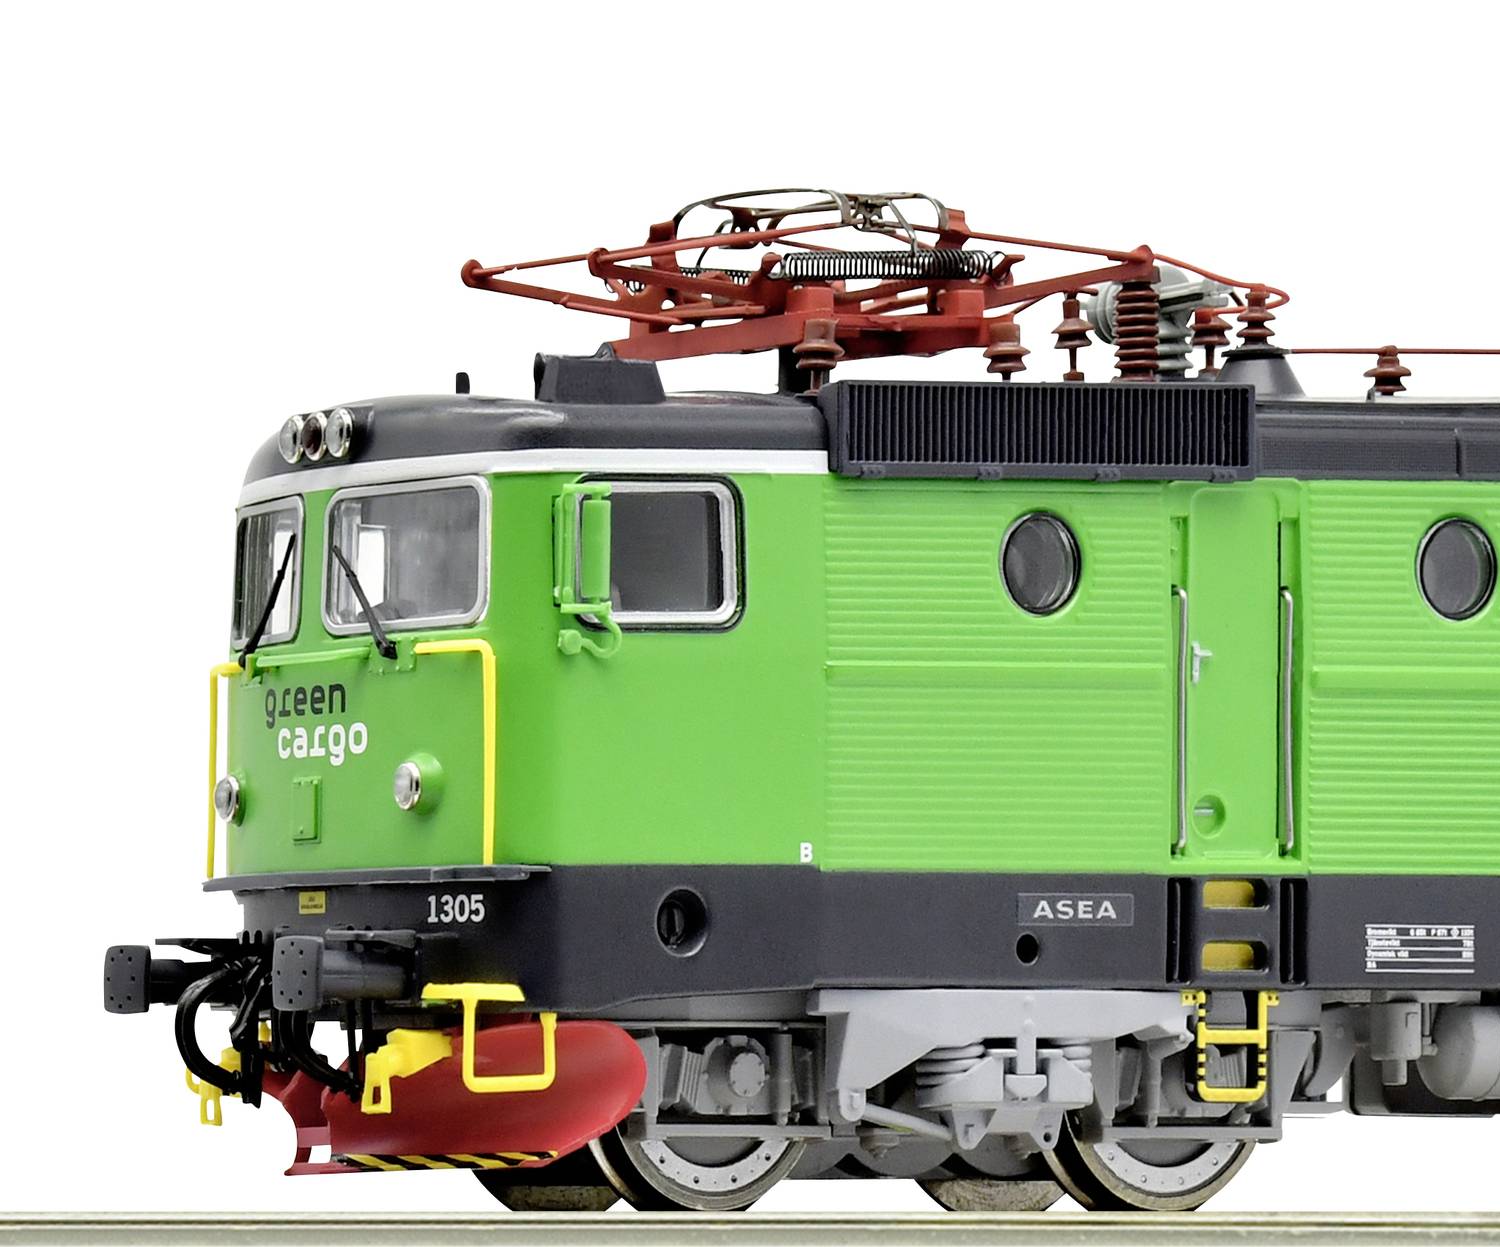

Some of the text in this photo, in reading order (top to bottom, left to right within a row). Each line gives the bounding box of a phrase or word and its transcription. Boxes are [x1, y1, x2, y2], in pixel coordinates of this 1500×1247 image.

[265, 682, 347, 730] green
[277, 722, 368, 766] cargo
[800, 842, 812, 863] B
[427, 894, 485, 923] 1305
[1033, 900, 1117, 919] ASEA
